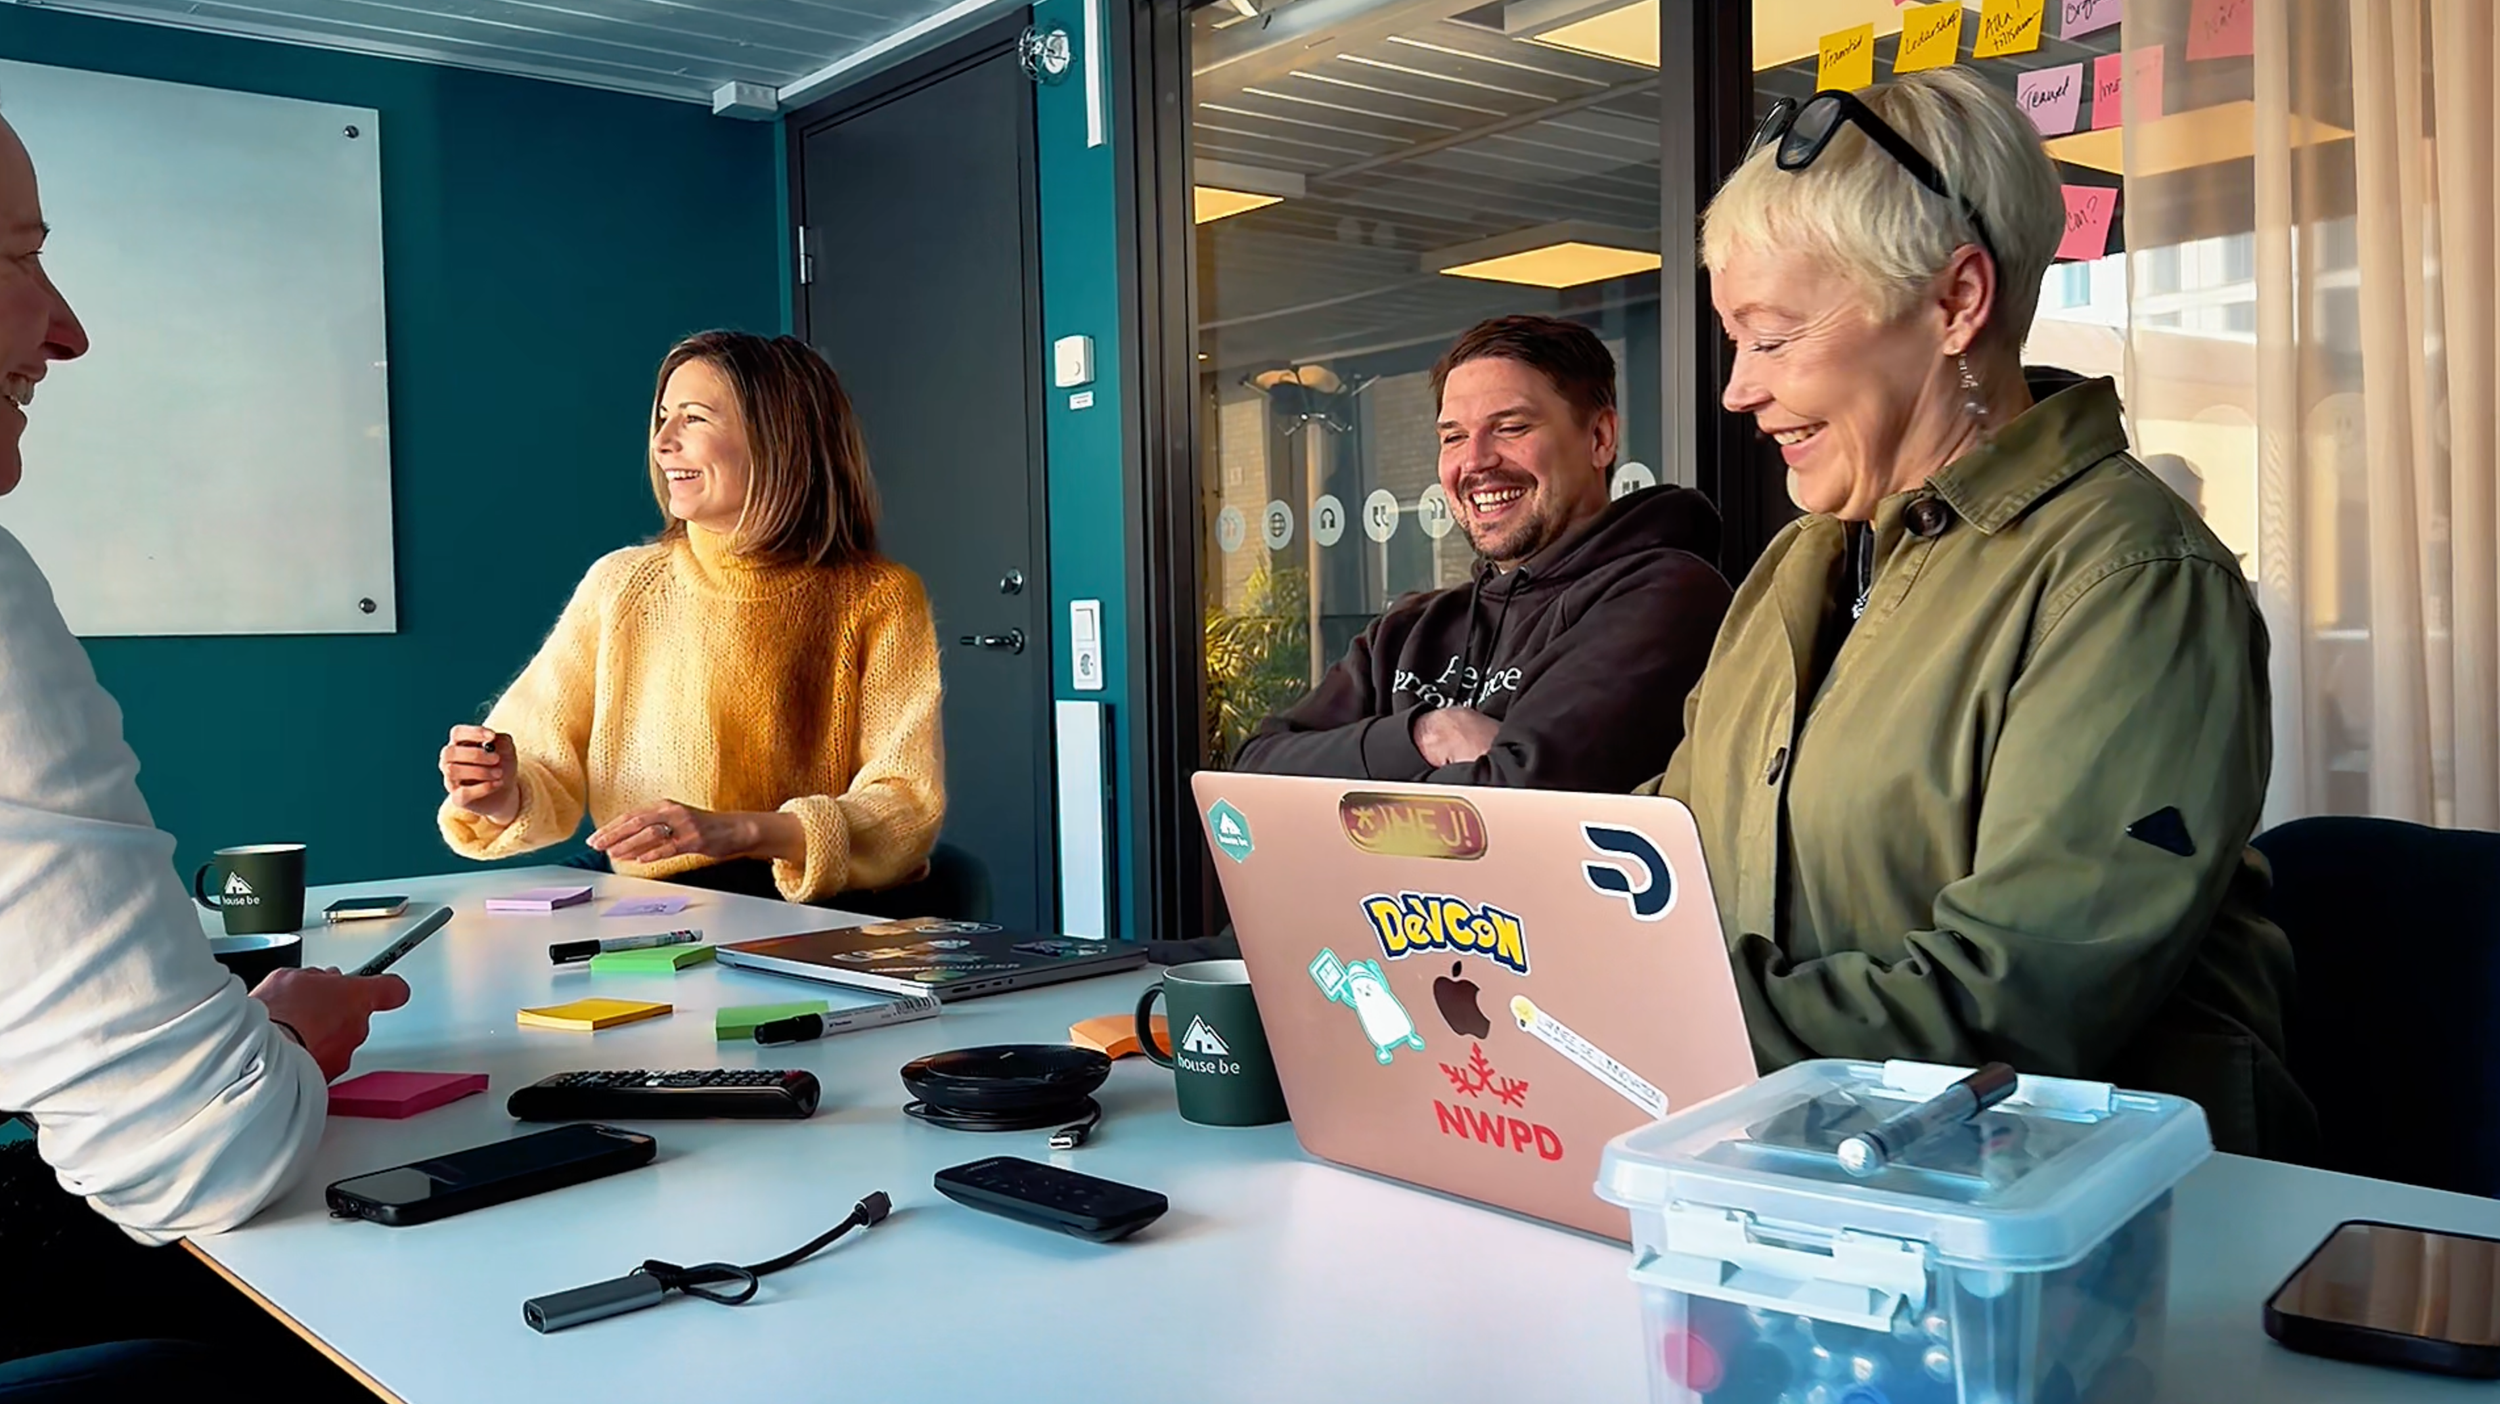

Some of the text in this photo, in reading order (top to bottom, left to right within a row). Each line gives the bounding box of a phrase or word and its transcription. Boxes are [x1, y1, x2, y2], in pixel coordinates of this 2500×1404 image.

[1177, 1051, 1241, 1075] house be
[1432, 1099, 1564, 1161] NWPD
